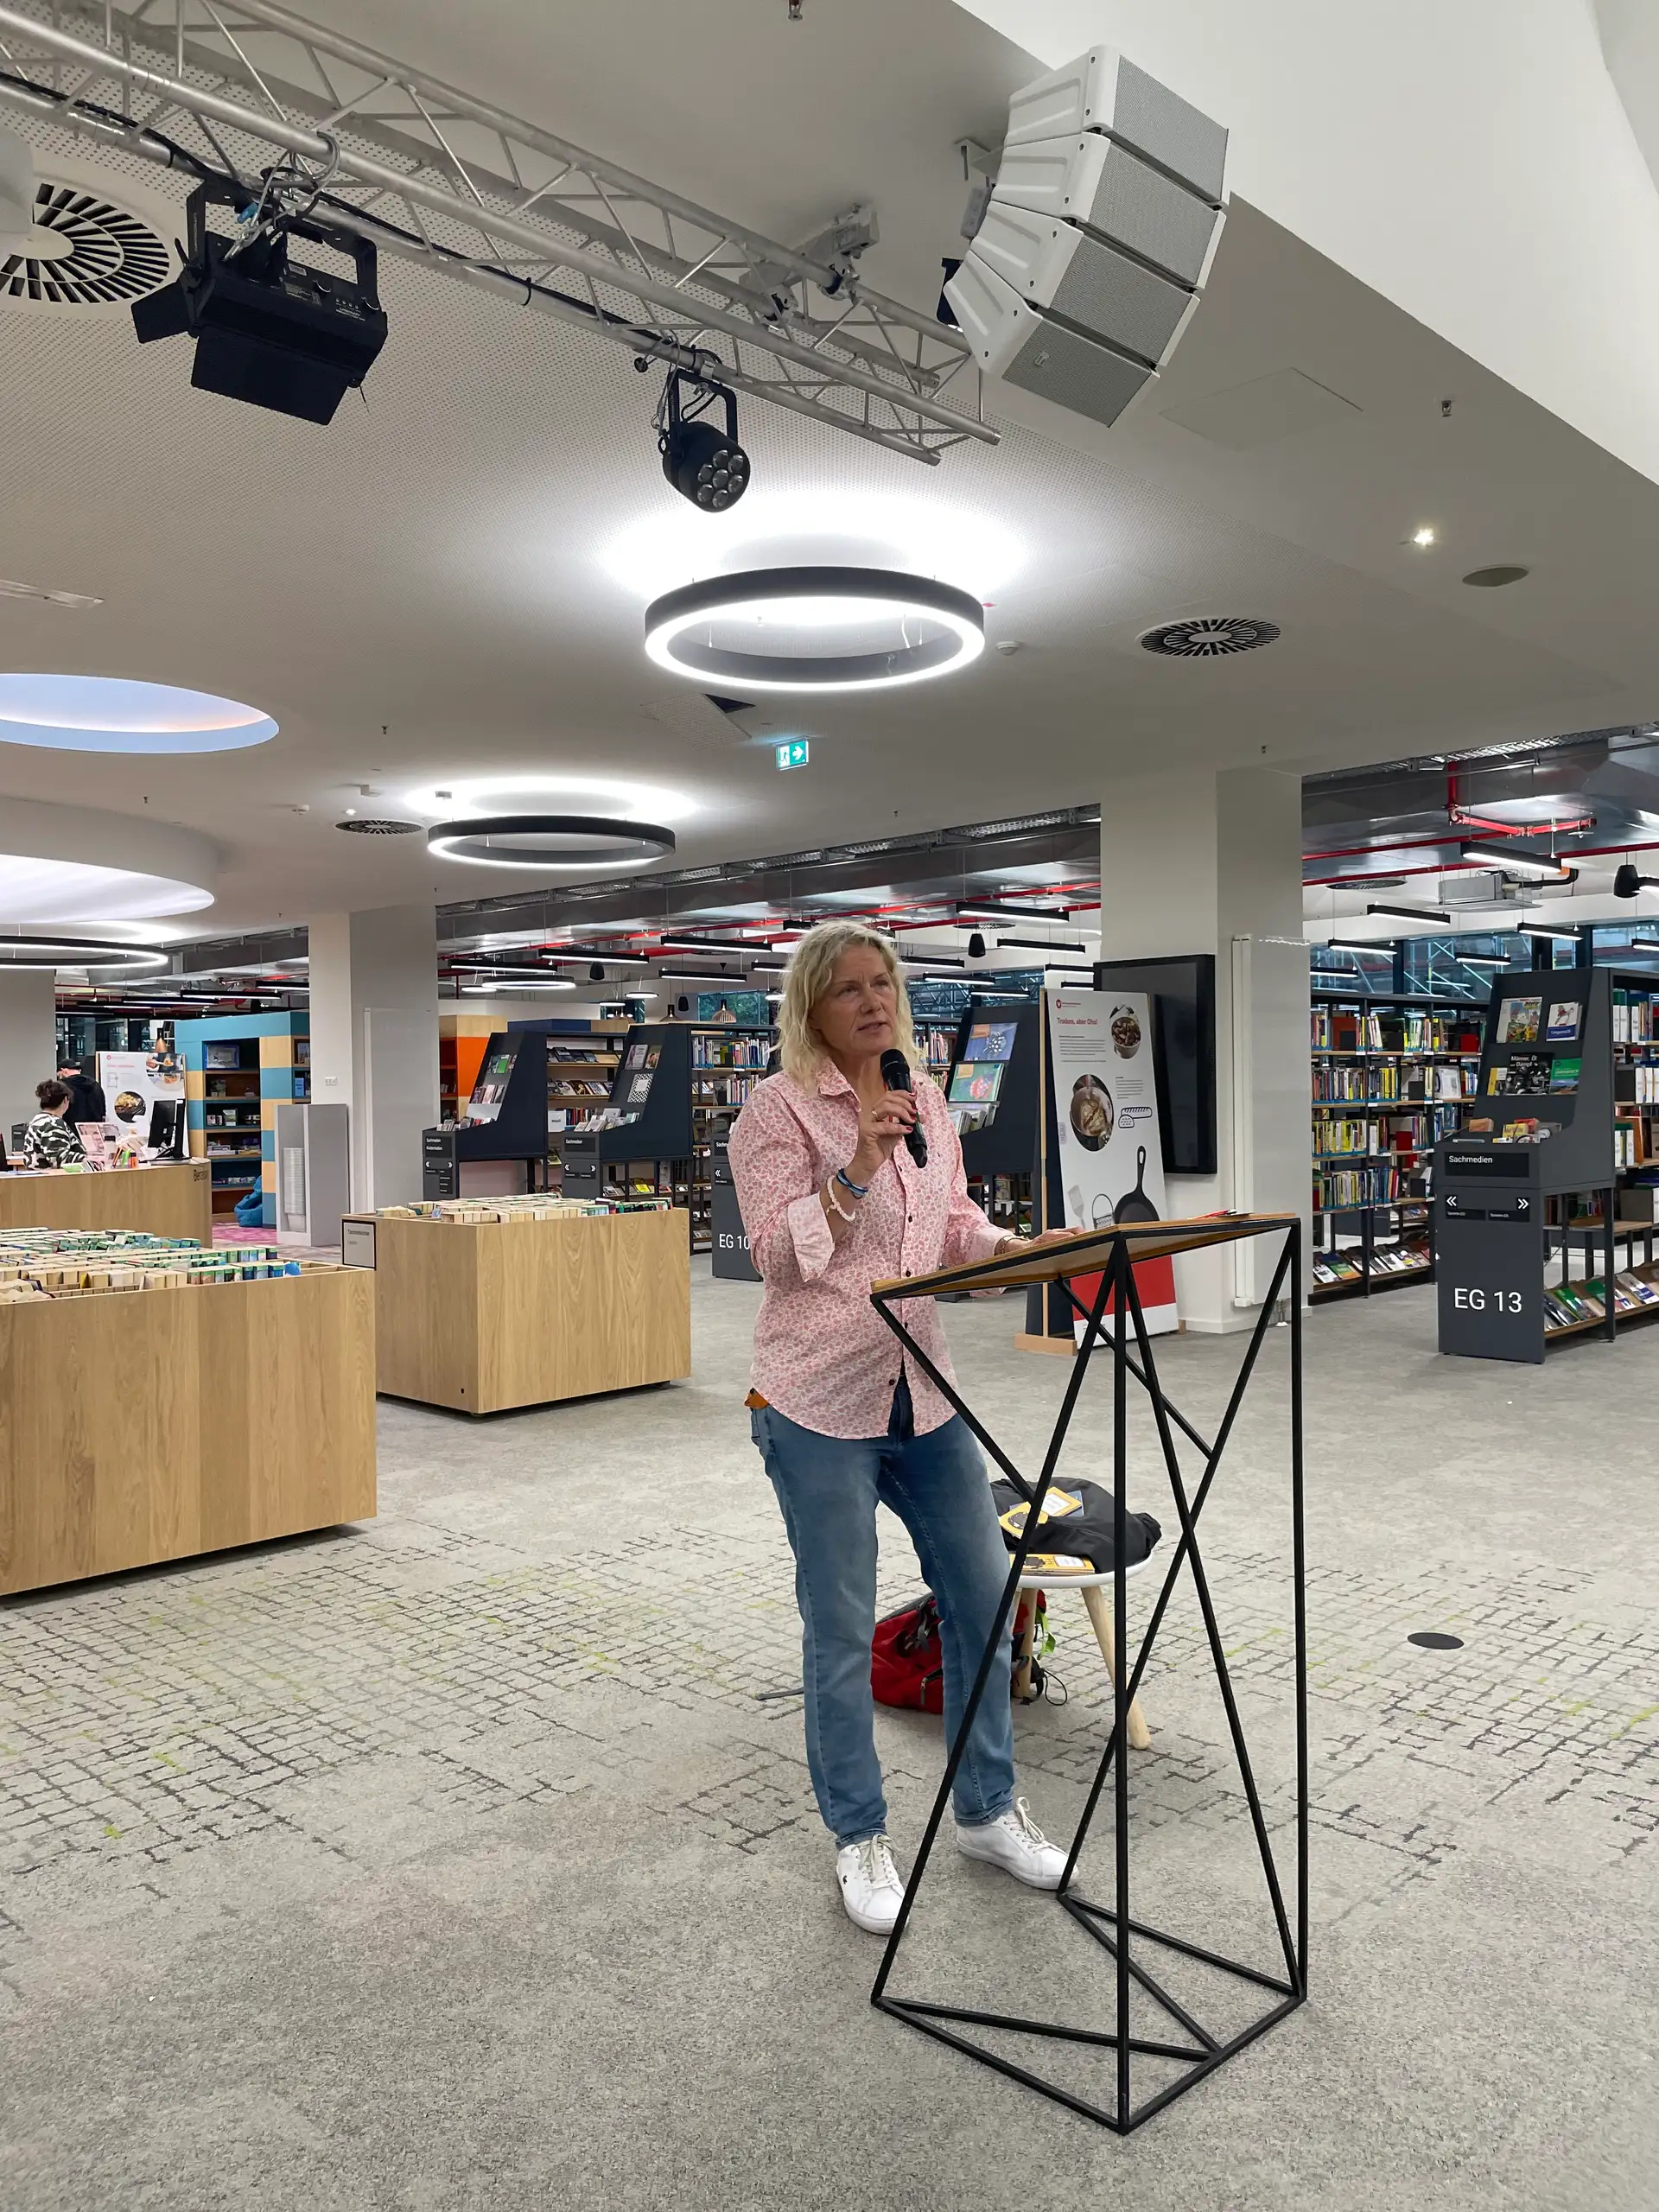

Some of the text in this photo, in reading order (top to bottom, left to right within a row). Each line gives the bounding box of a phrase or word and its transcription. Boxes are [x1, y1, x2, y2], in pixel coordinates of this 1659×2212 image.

[1448, 1155, 1493, 1164] Sachmedien
[719, 1233, 750, 1250] EG 10
[1454, 1287, 1522, 1313] EG 13
